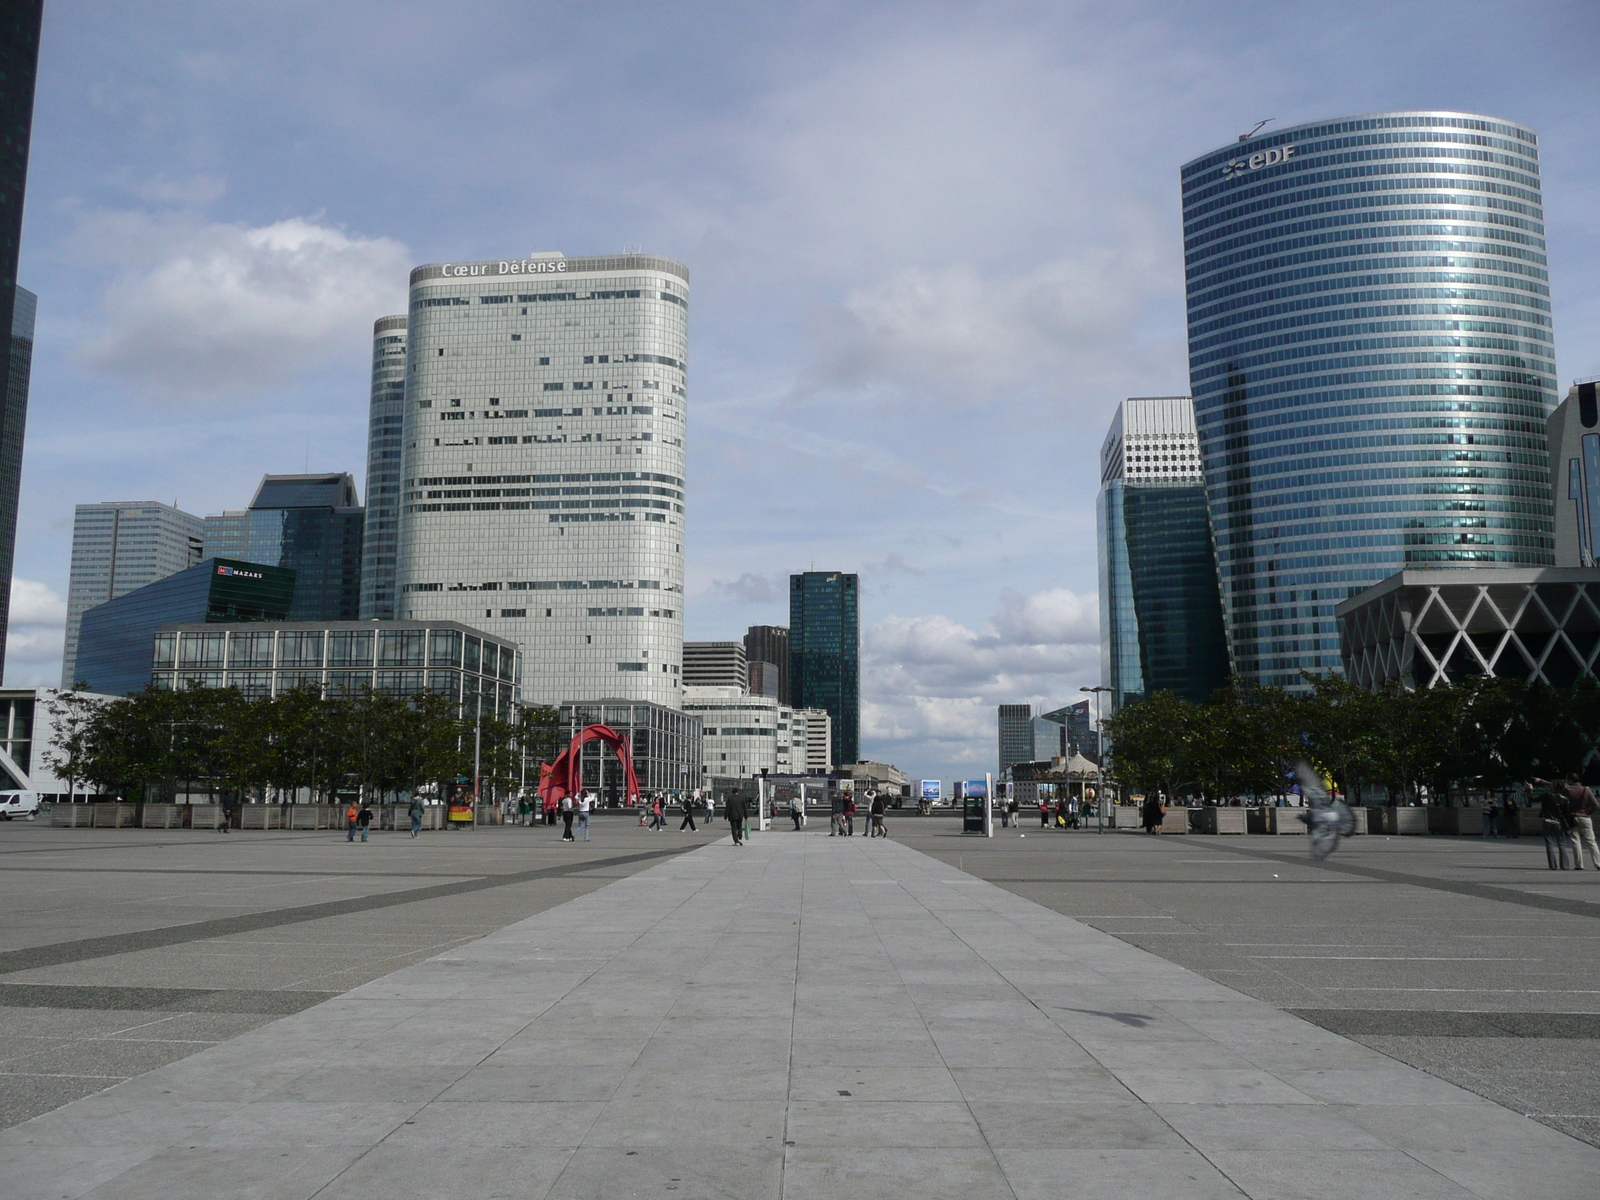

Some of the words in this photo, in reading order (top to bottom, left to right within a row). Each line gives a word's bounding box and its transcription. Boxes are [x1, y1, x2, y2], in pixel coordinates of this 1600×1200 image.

[442, 263, 487, 277] Cœur
[499, 259, 566, 275] Défense
[233, 569, 263, 579] MAZARS
